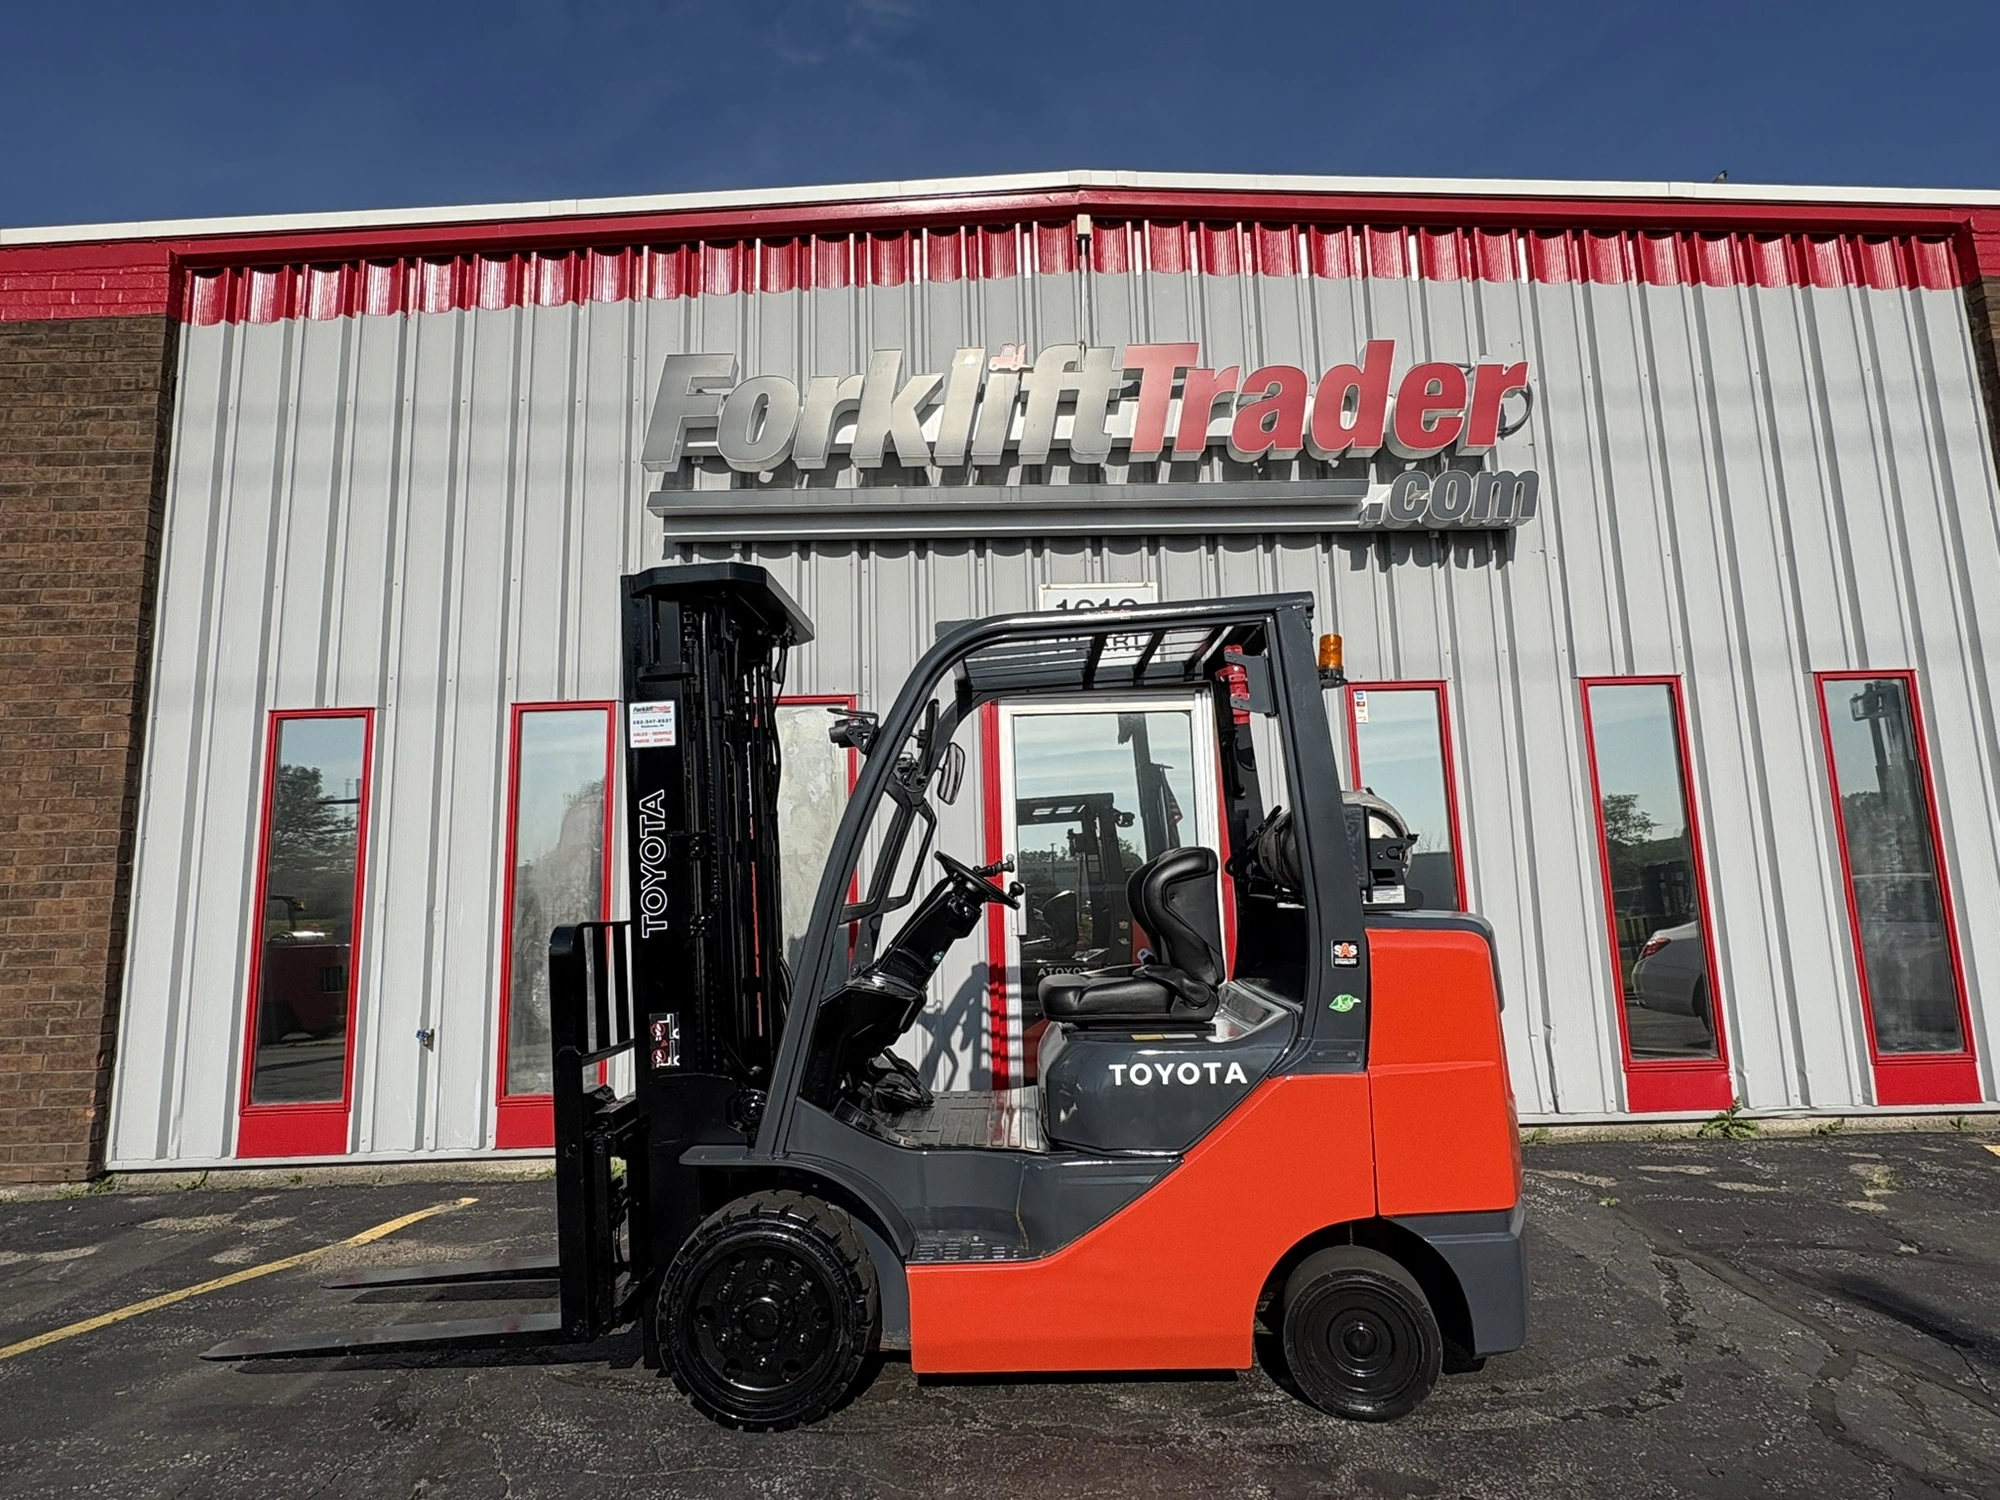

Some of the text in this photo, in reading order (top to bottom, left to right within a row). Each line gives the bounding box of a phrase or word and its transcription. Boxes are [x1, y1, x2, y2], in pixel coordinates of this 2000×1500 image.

[641, 339, 1530, 467] ForkliftTrader
[1363, 469, 1540, 525] .com
[639, 789, 668, 939] TOYOTA
[1333, 942, 1357, 957] SAS
[1108, 1062, 1248, 1086] TOYOTA
